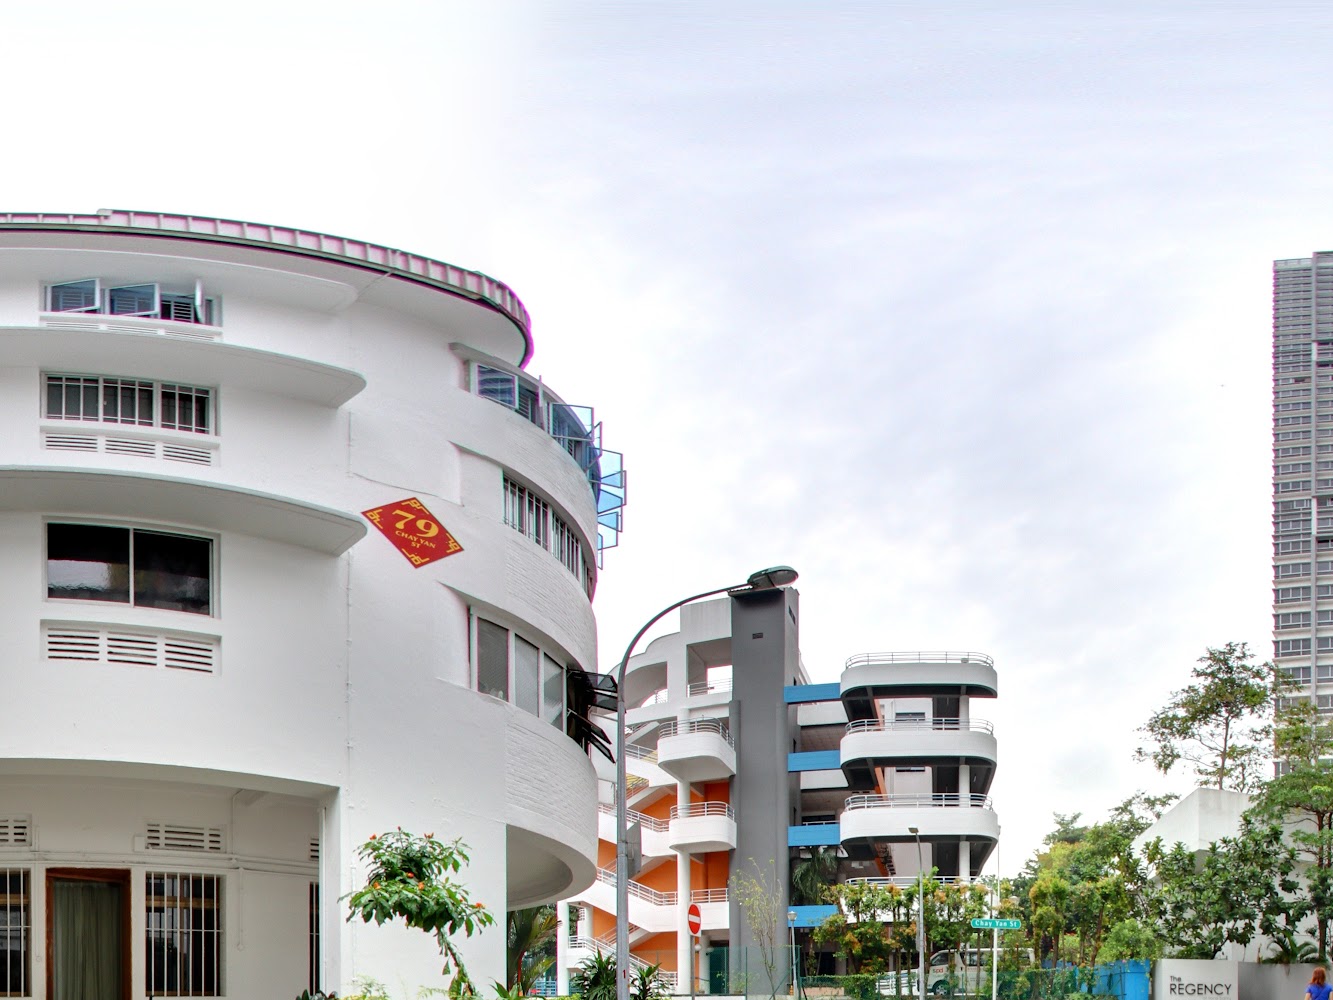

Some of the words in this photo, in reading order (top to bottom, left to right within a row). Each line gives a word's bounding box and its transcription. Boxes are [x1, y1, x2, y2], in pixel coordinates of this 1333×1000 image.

[392, 510, 438, 537] 79
[395, 530, 418, 542] CHAY
[420, 538, 436, 548] YAN
[1170, 983, 1232, 995] REGENCY
